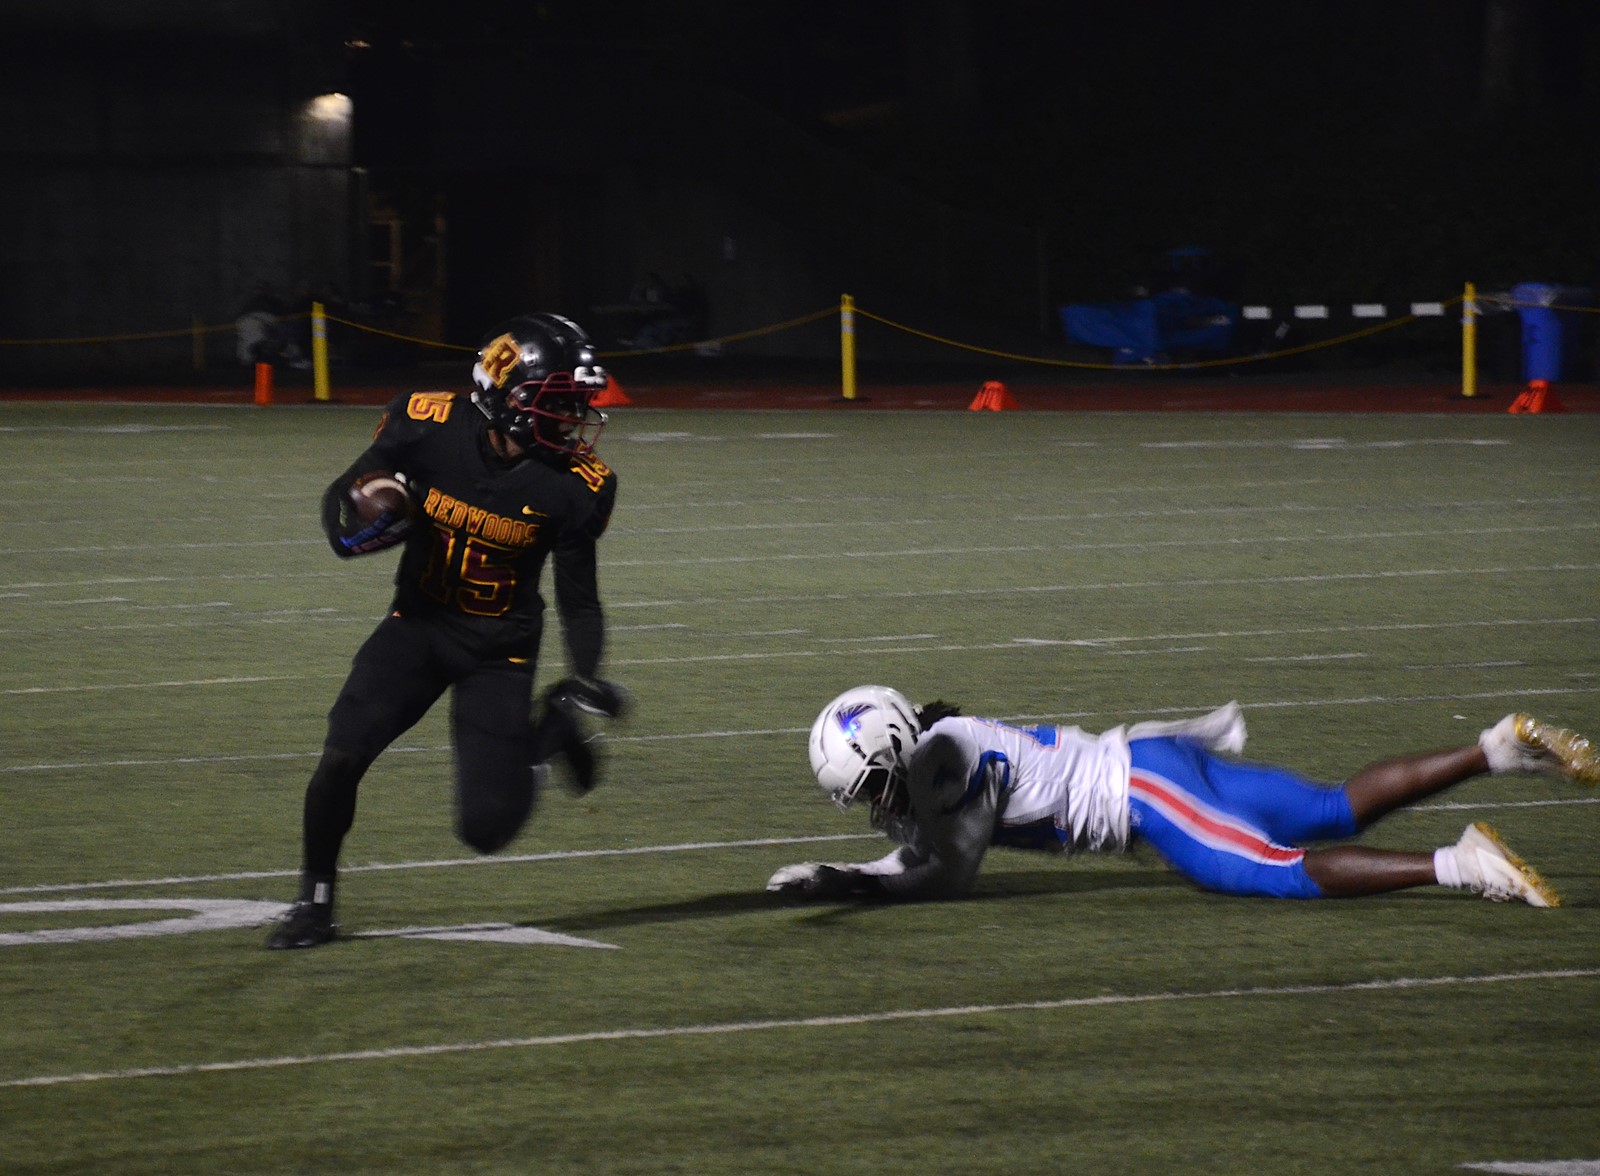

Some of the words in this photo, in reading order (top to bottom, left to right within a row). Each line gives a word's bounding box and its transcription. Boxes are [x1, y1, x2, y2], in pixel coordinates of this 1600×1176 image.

[407, 391, 457, 424] 15
[422, 487, 541, 547] REDWOODS
[419, 521, 519, 617] 15
